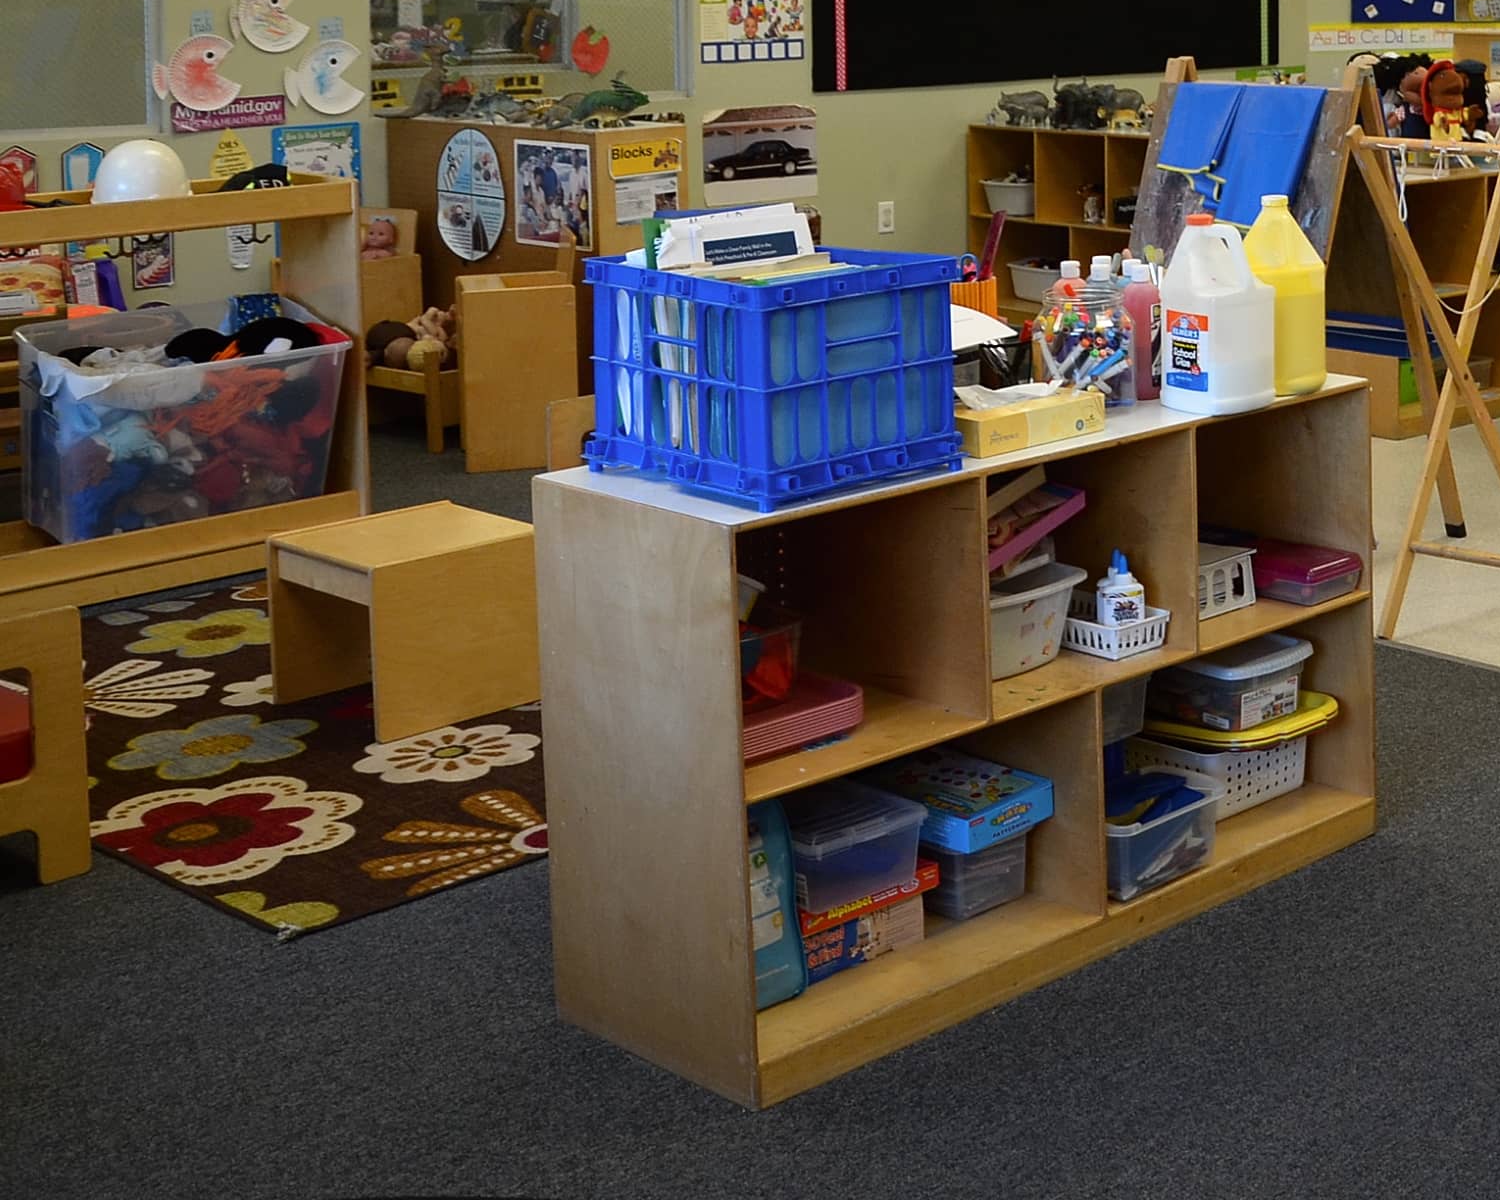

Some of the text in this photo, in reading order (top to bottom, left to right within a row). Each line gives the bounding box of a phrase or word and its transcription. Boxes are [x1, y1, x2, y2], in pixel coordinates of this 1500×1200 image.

[1313, 31, 1332, 45] Aa
[1338, 31, 1355, 45] Bb
[1361, 30, 1379, 44] Cc
[1385, 29, 1404, 44] Dd
[1410, 30, 1425, 43] Ee
[611, 146, 653, 160] Blocks
[1173, 347, 1196, 359] School
[827, 895, 873, 920] Alphabet
